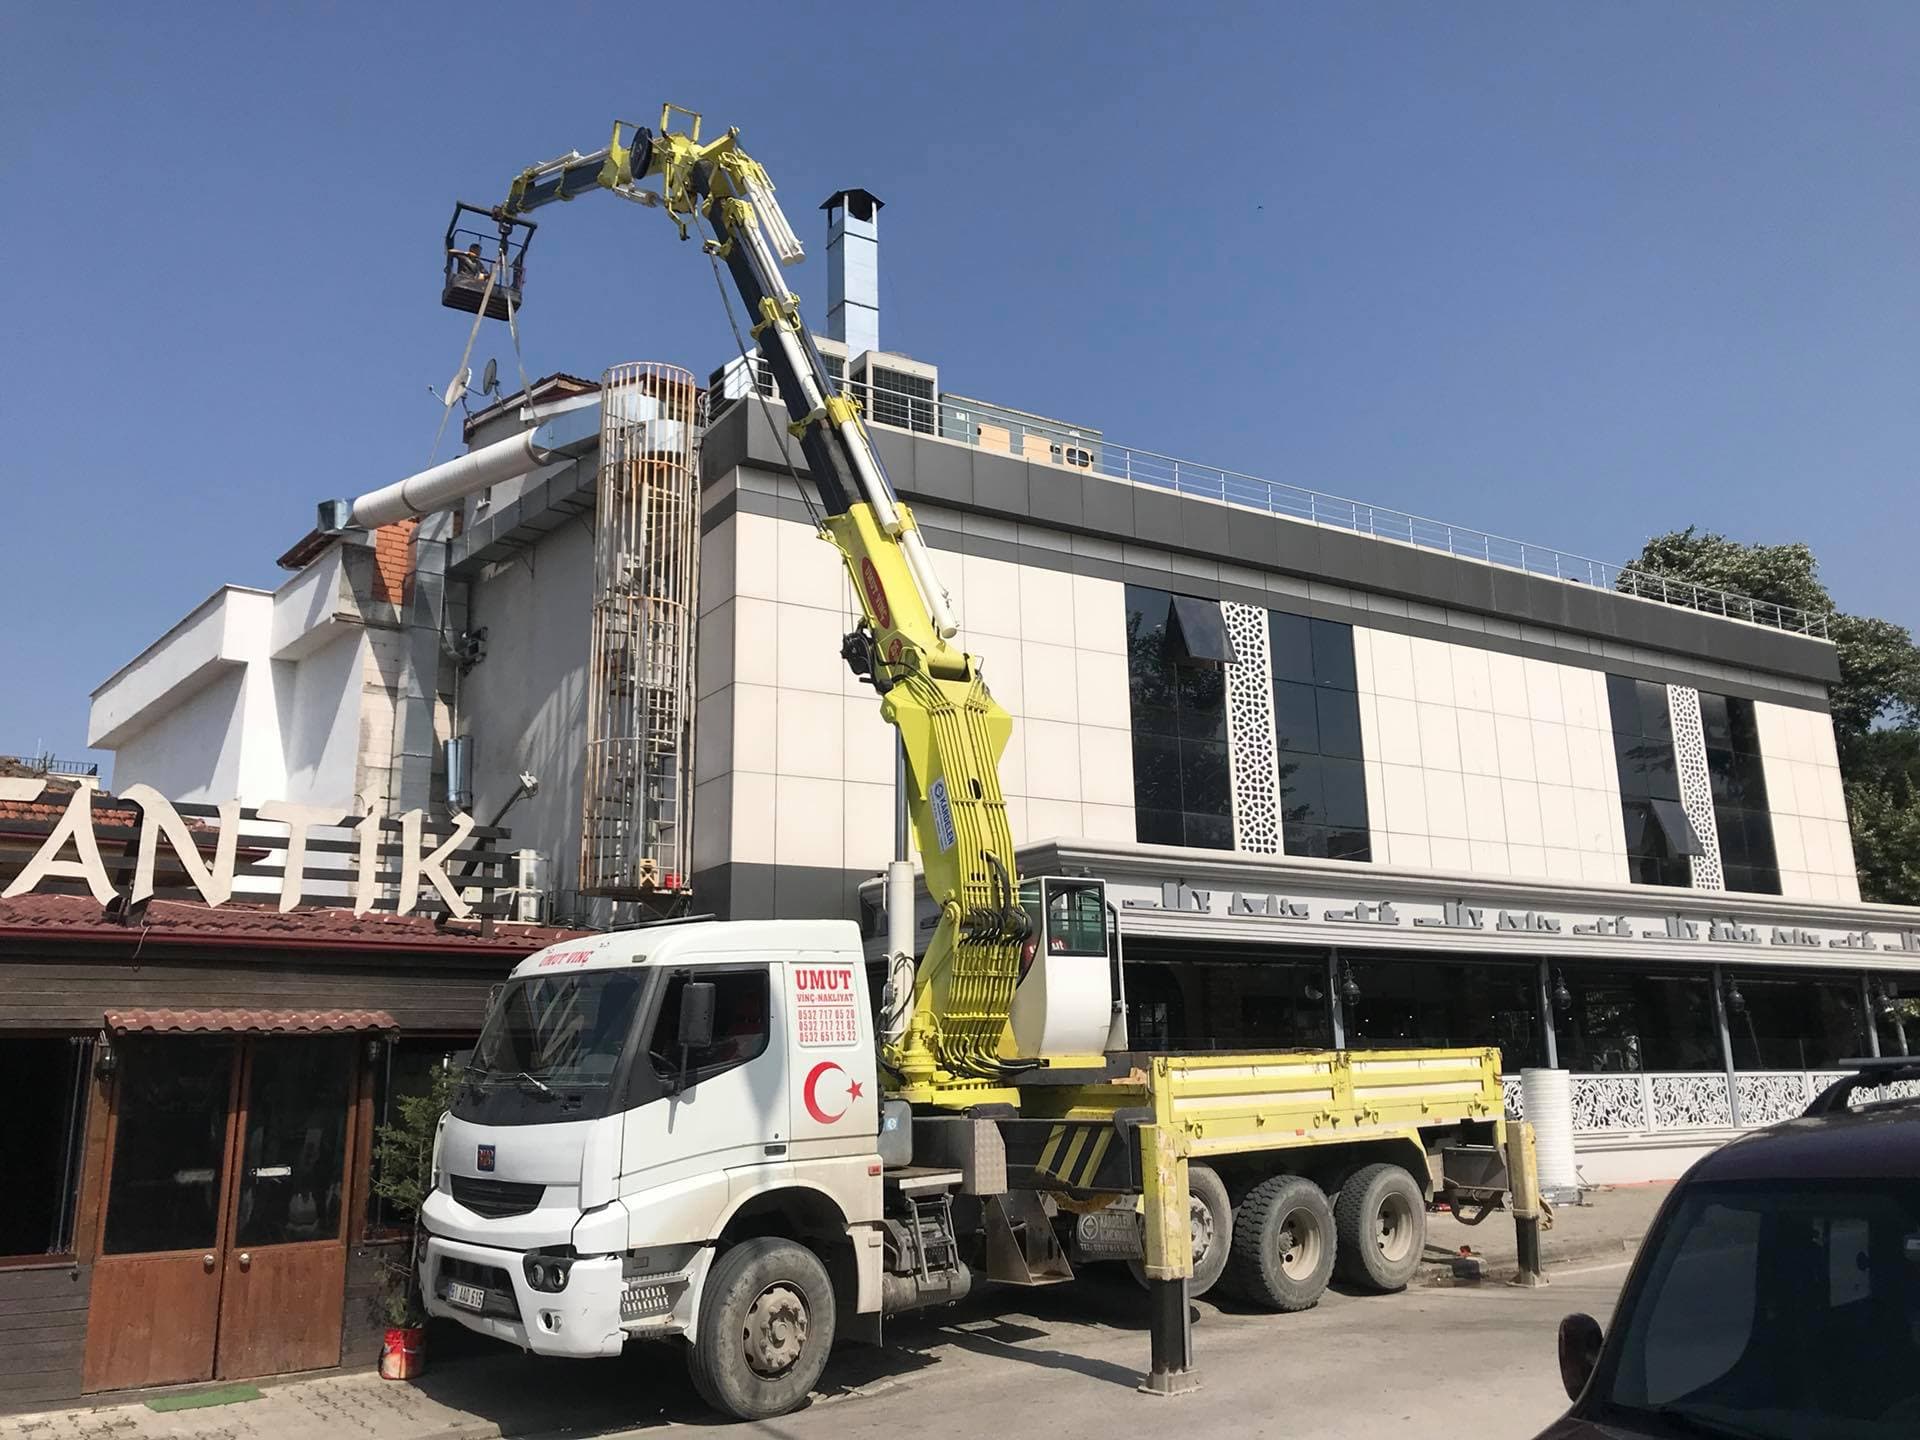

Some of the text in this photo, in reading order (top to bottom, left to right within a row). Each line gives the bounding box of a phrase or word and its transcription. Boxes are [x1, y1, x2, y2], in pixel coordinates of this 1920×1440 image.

[940, 796, 954, 846] KARDELEN
[795, 970, 852, 990] UMUT
[798, 1009, 817, 1020] 0532
[819, 1009, 832, 1020] 717
[799, 1020, 817, 1031] 0532
[820, 1020, 833, 1030] 717
[836, 1020, 844, 1030] 21
[799, 1031, 818, 1042] 0532
[837, 1031, 845, 1041] 25
[847, 1031, 856, 1041] 22
